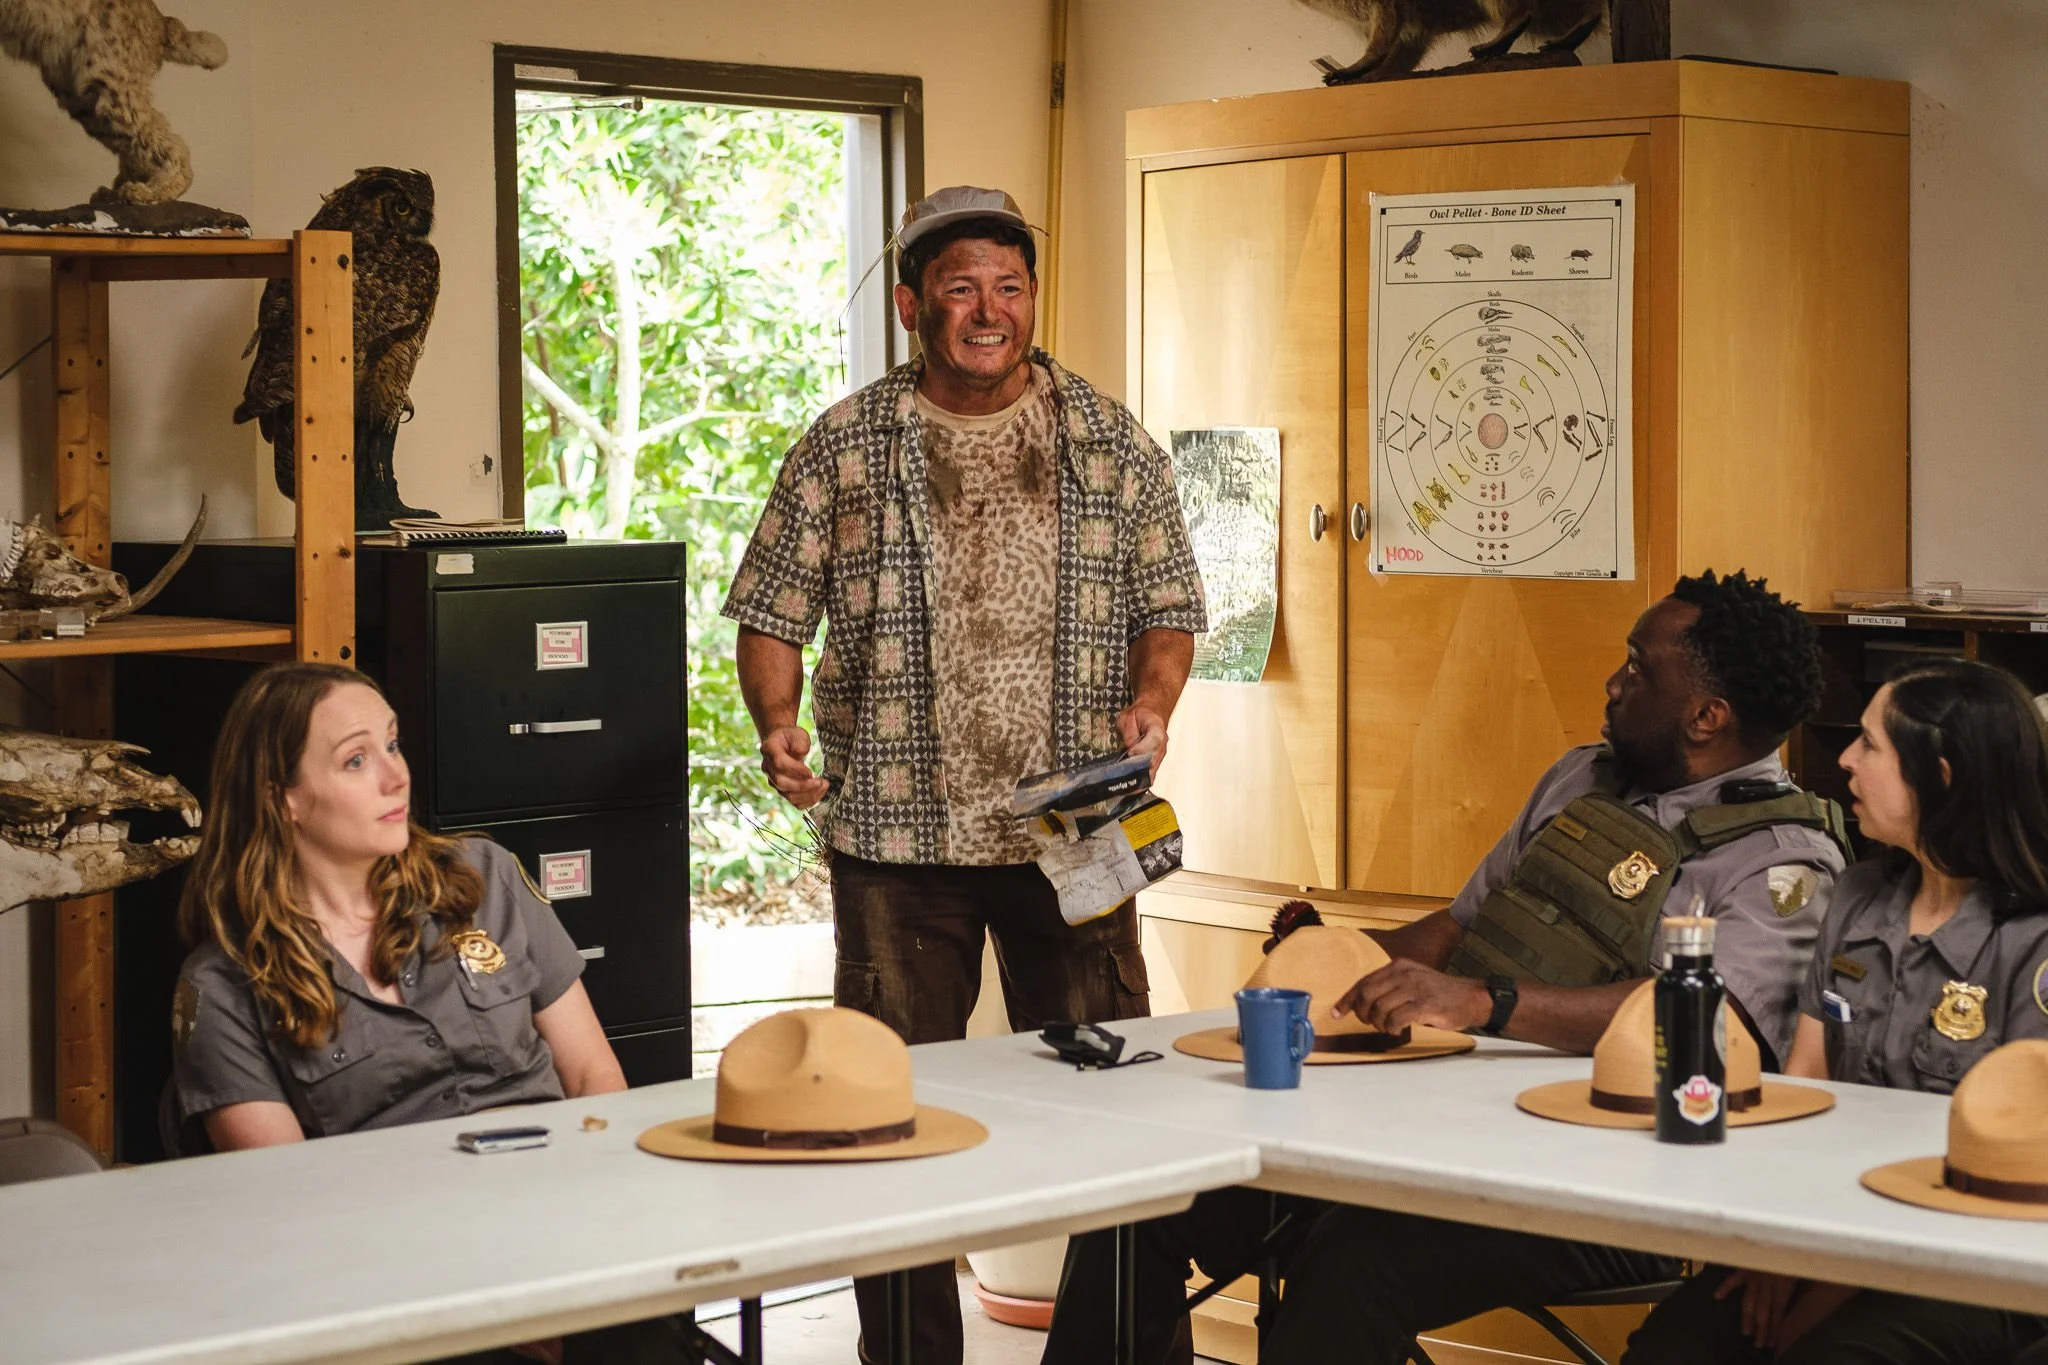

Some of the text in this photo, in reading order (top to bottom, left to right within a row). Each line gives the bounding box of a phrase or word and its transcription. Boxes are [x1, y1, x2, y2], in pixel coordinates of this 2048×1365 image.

[1429, 208, 1449, 219] Owl
[1452, 207, 1482, 218] Pellet
[1491, 206, 1517, 217] Bone
[1520, 205, 1534, 216] ID
[1536, 204, 1566, 215] Sheet
[1385, 545, 1424, 564] HOOD
[1862, 617, 1892, 625] PELTS
